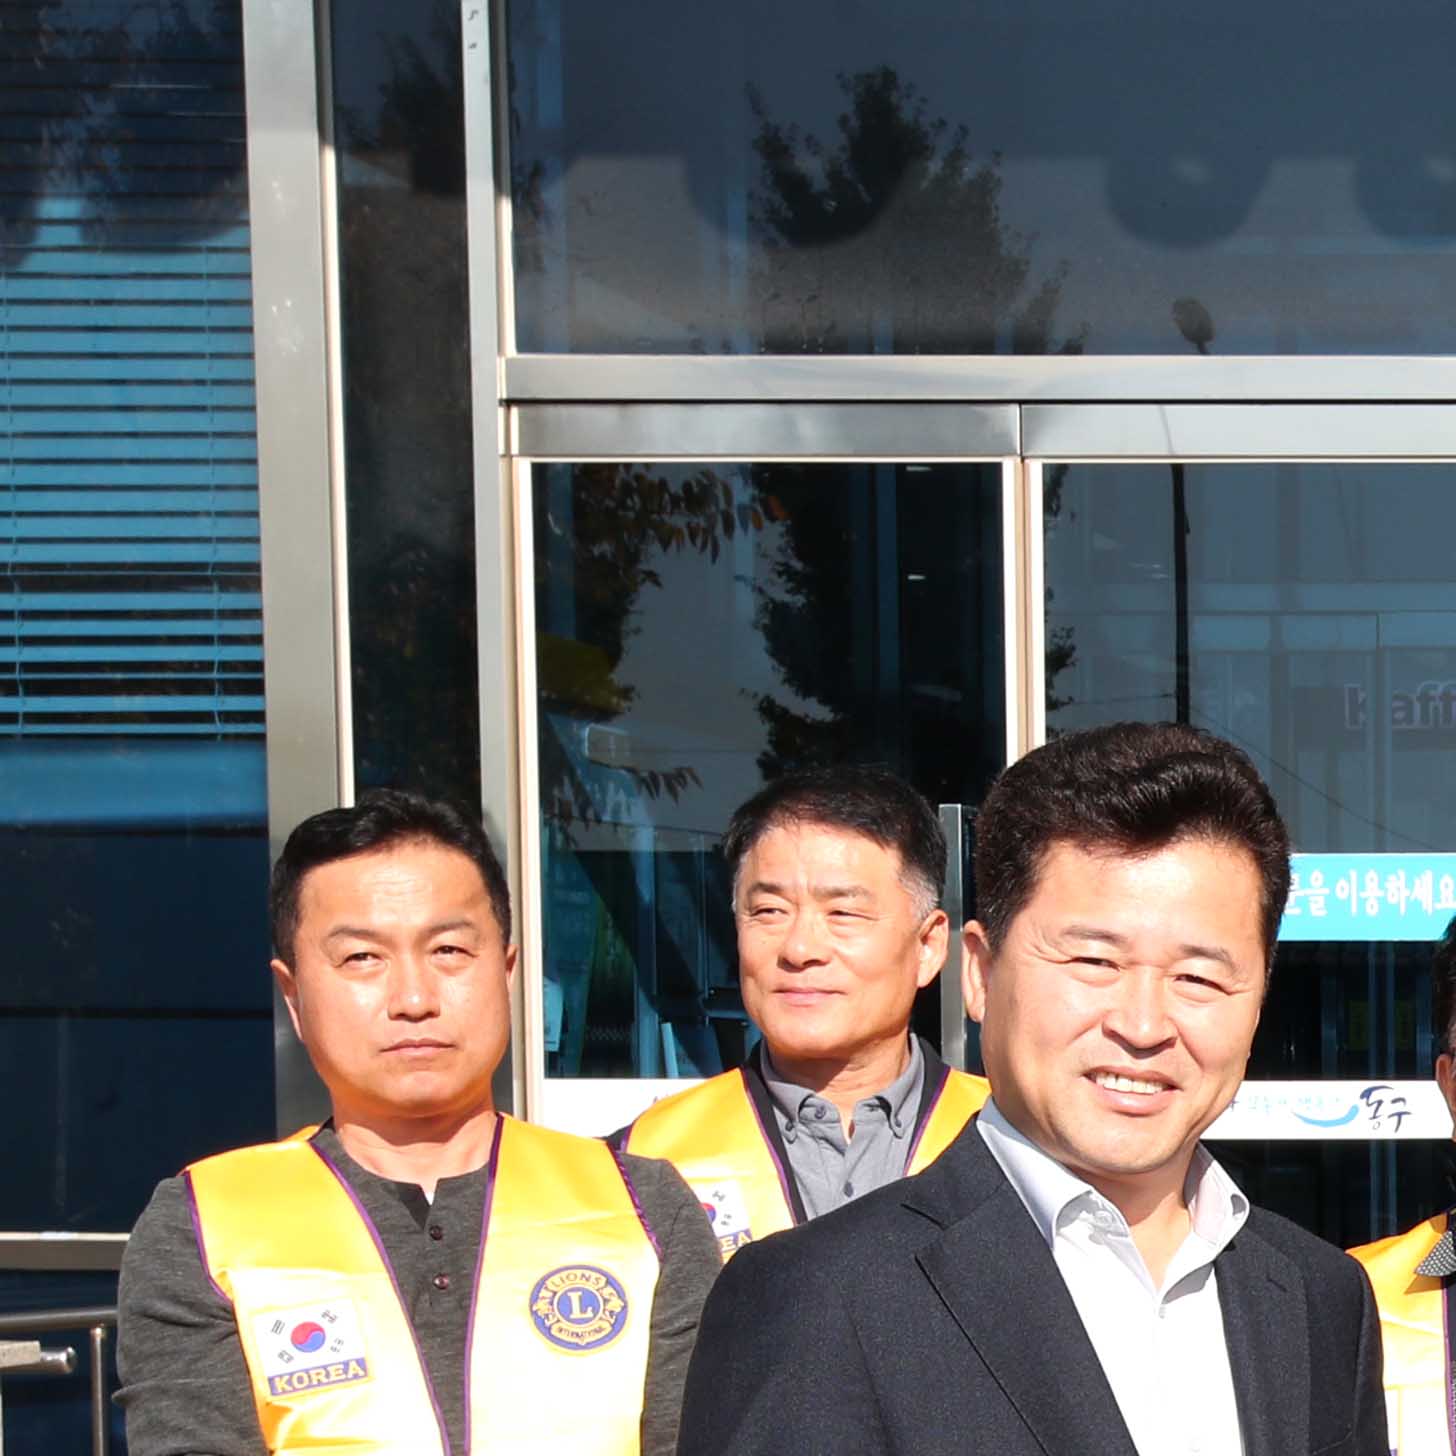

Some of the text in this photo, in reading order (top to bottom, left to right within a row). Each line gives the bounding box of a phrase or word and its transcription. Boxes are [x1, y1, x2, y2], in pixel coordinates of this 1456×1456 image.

[551, 1273, 602, 1288] LIONS
[567, 1291, 594, 1319] L
[274, 1360, 366, 1393] KOREA
